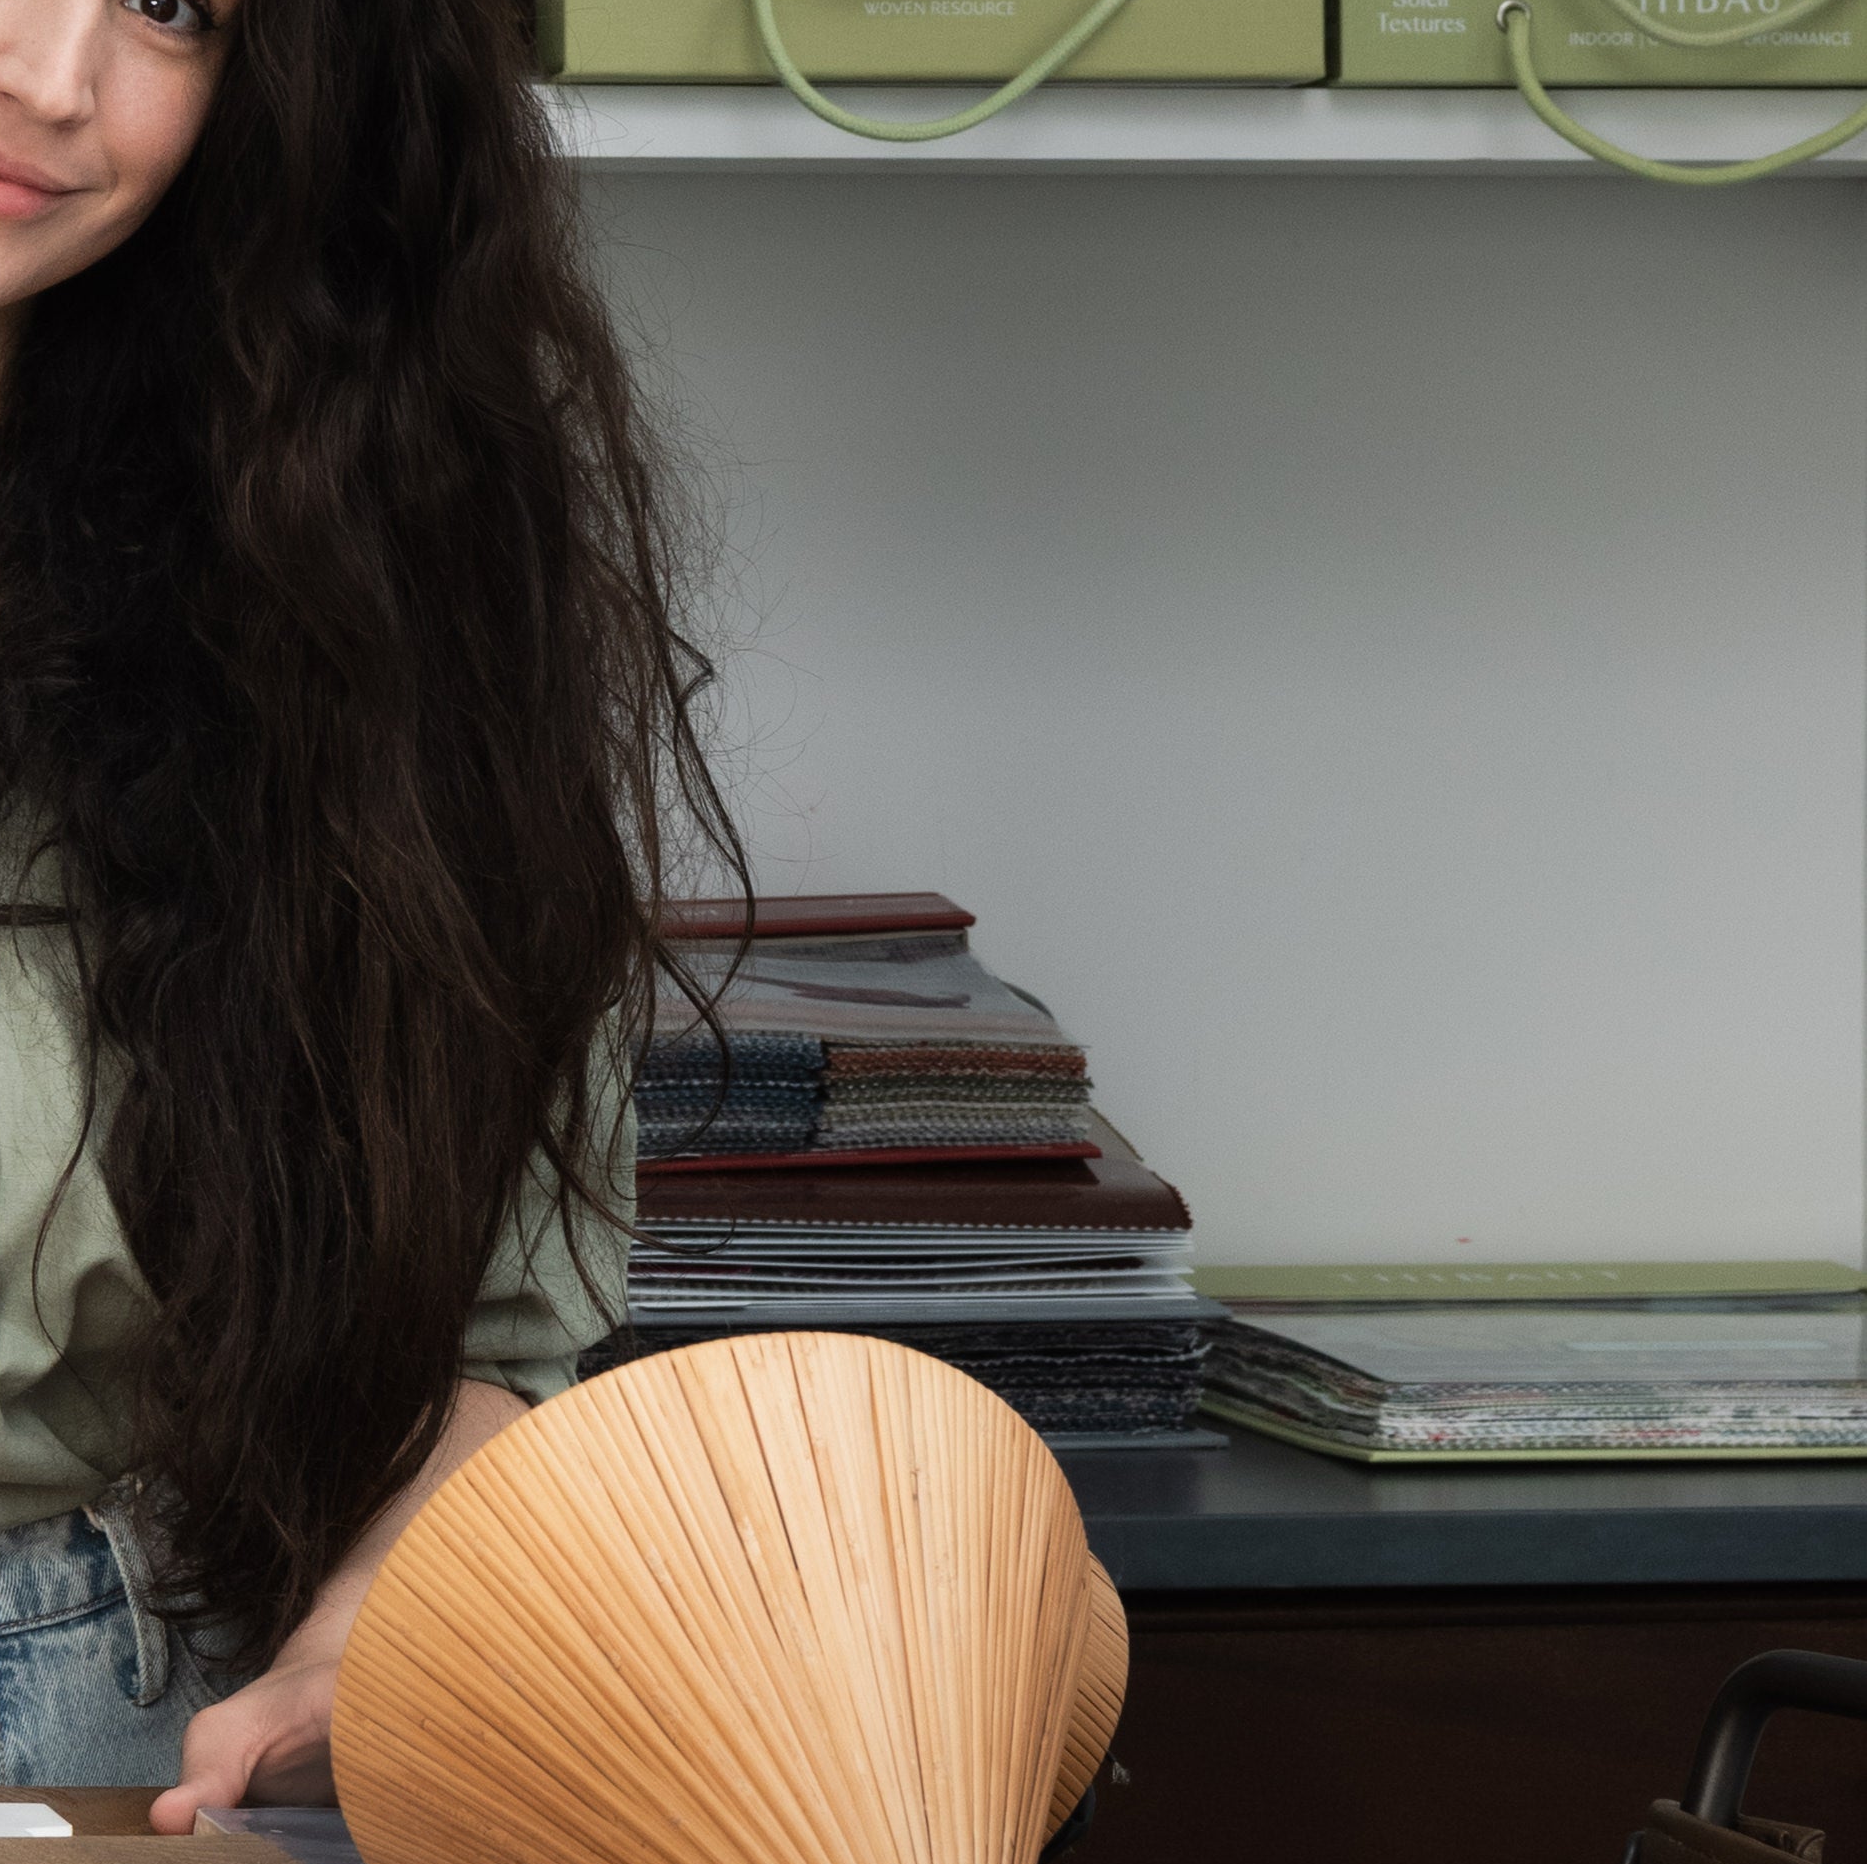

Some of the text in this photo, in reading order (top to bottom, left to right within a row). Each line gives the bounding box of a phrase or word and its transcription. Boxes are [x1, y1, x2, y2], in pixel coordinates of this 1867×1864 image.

[863, 0, 1016, 17] WOVEN RESOURCE
[1379, 12, 1467, 34] Textures
[1567, 31, 1635, 47] INDOOR
